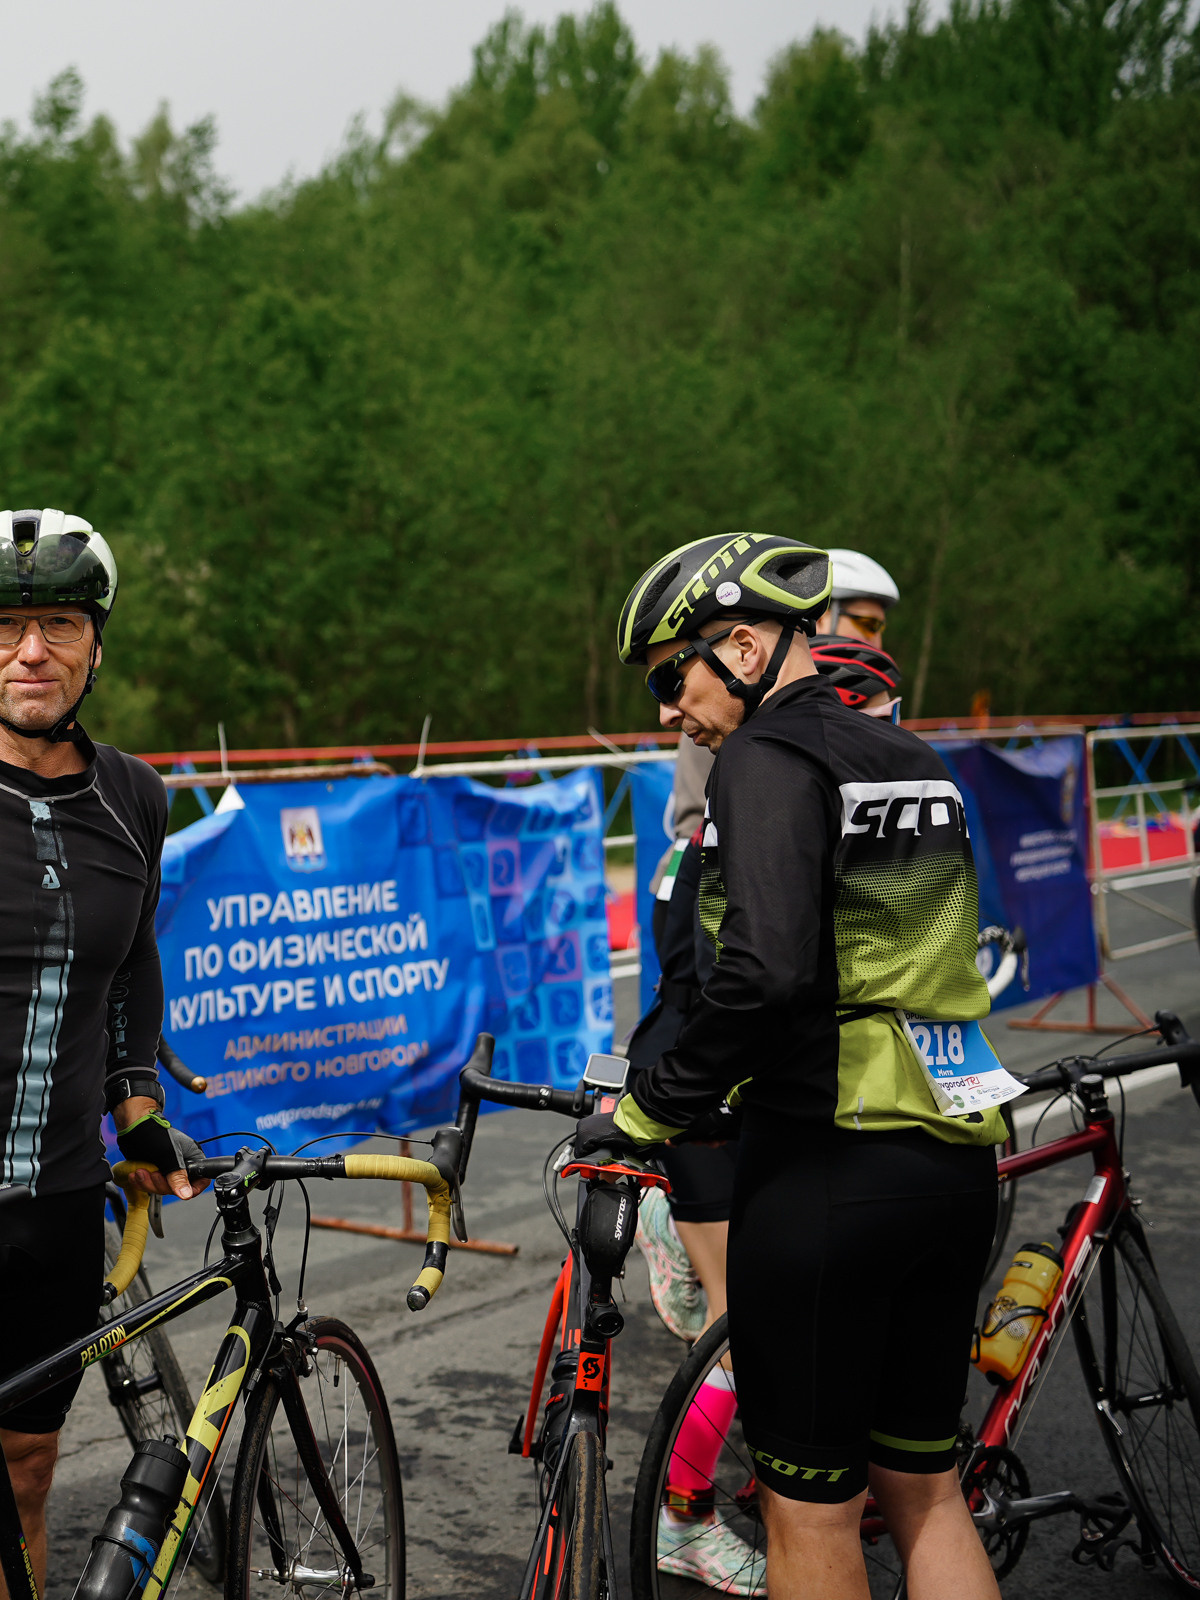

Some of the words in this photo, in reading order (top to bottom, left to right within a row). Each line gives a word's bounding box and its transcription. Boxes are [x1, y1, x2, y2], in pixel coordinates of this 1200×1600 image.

[850, 796, 968, 838] SCO
[206, 879, 399, 932] УПРАВЛЕНИЕ
[184, 943, 223, 982] ПО
[228, 912, 428, 974] ФИЗИЧЕСКОЙ
[169, 976, 317, 1033] КУЛЬТУРЕ
[323, 974, 345, 1008] И
[348, 957, 450, 1003] СПОРТУ
[224, 1013, 408, 1062] АДМИНИСТРАЦИИ
[912, 1024, 965, 1066] 218
[204, 1061, 311, 1099] ВЕЛИКОГО
[80, 1324, 127, 1364] PELOTON
[22, 1548, 33, 1576] Road
